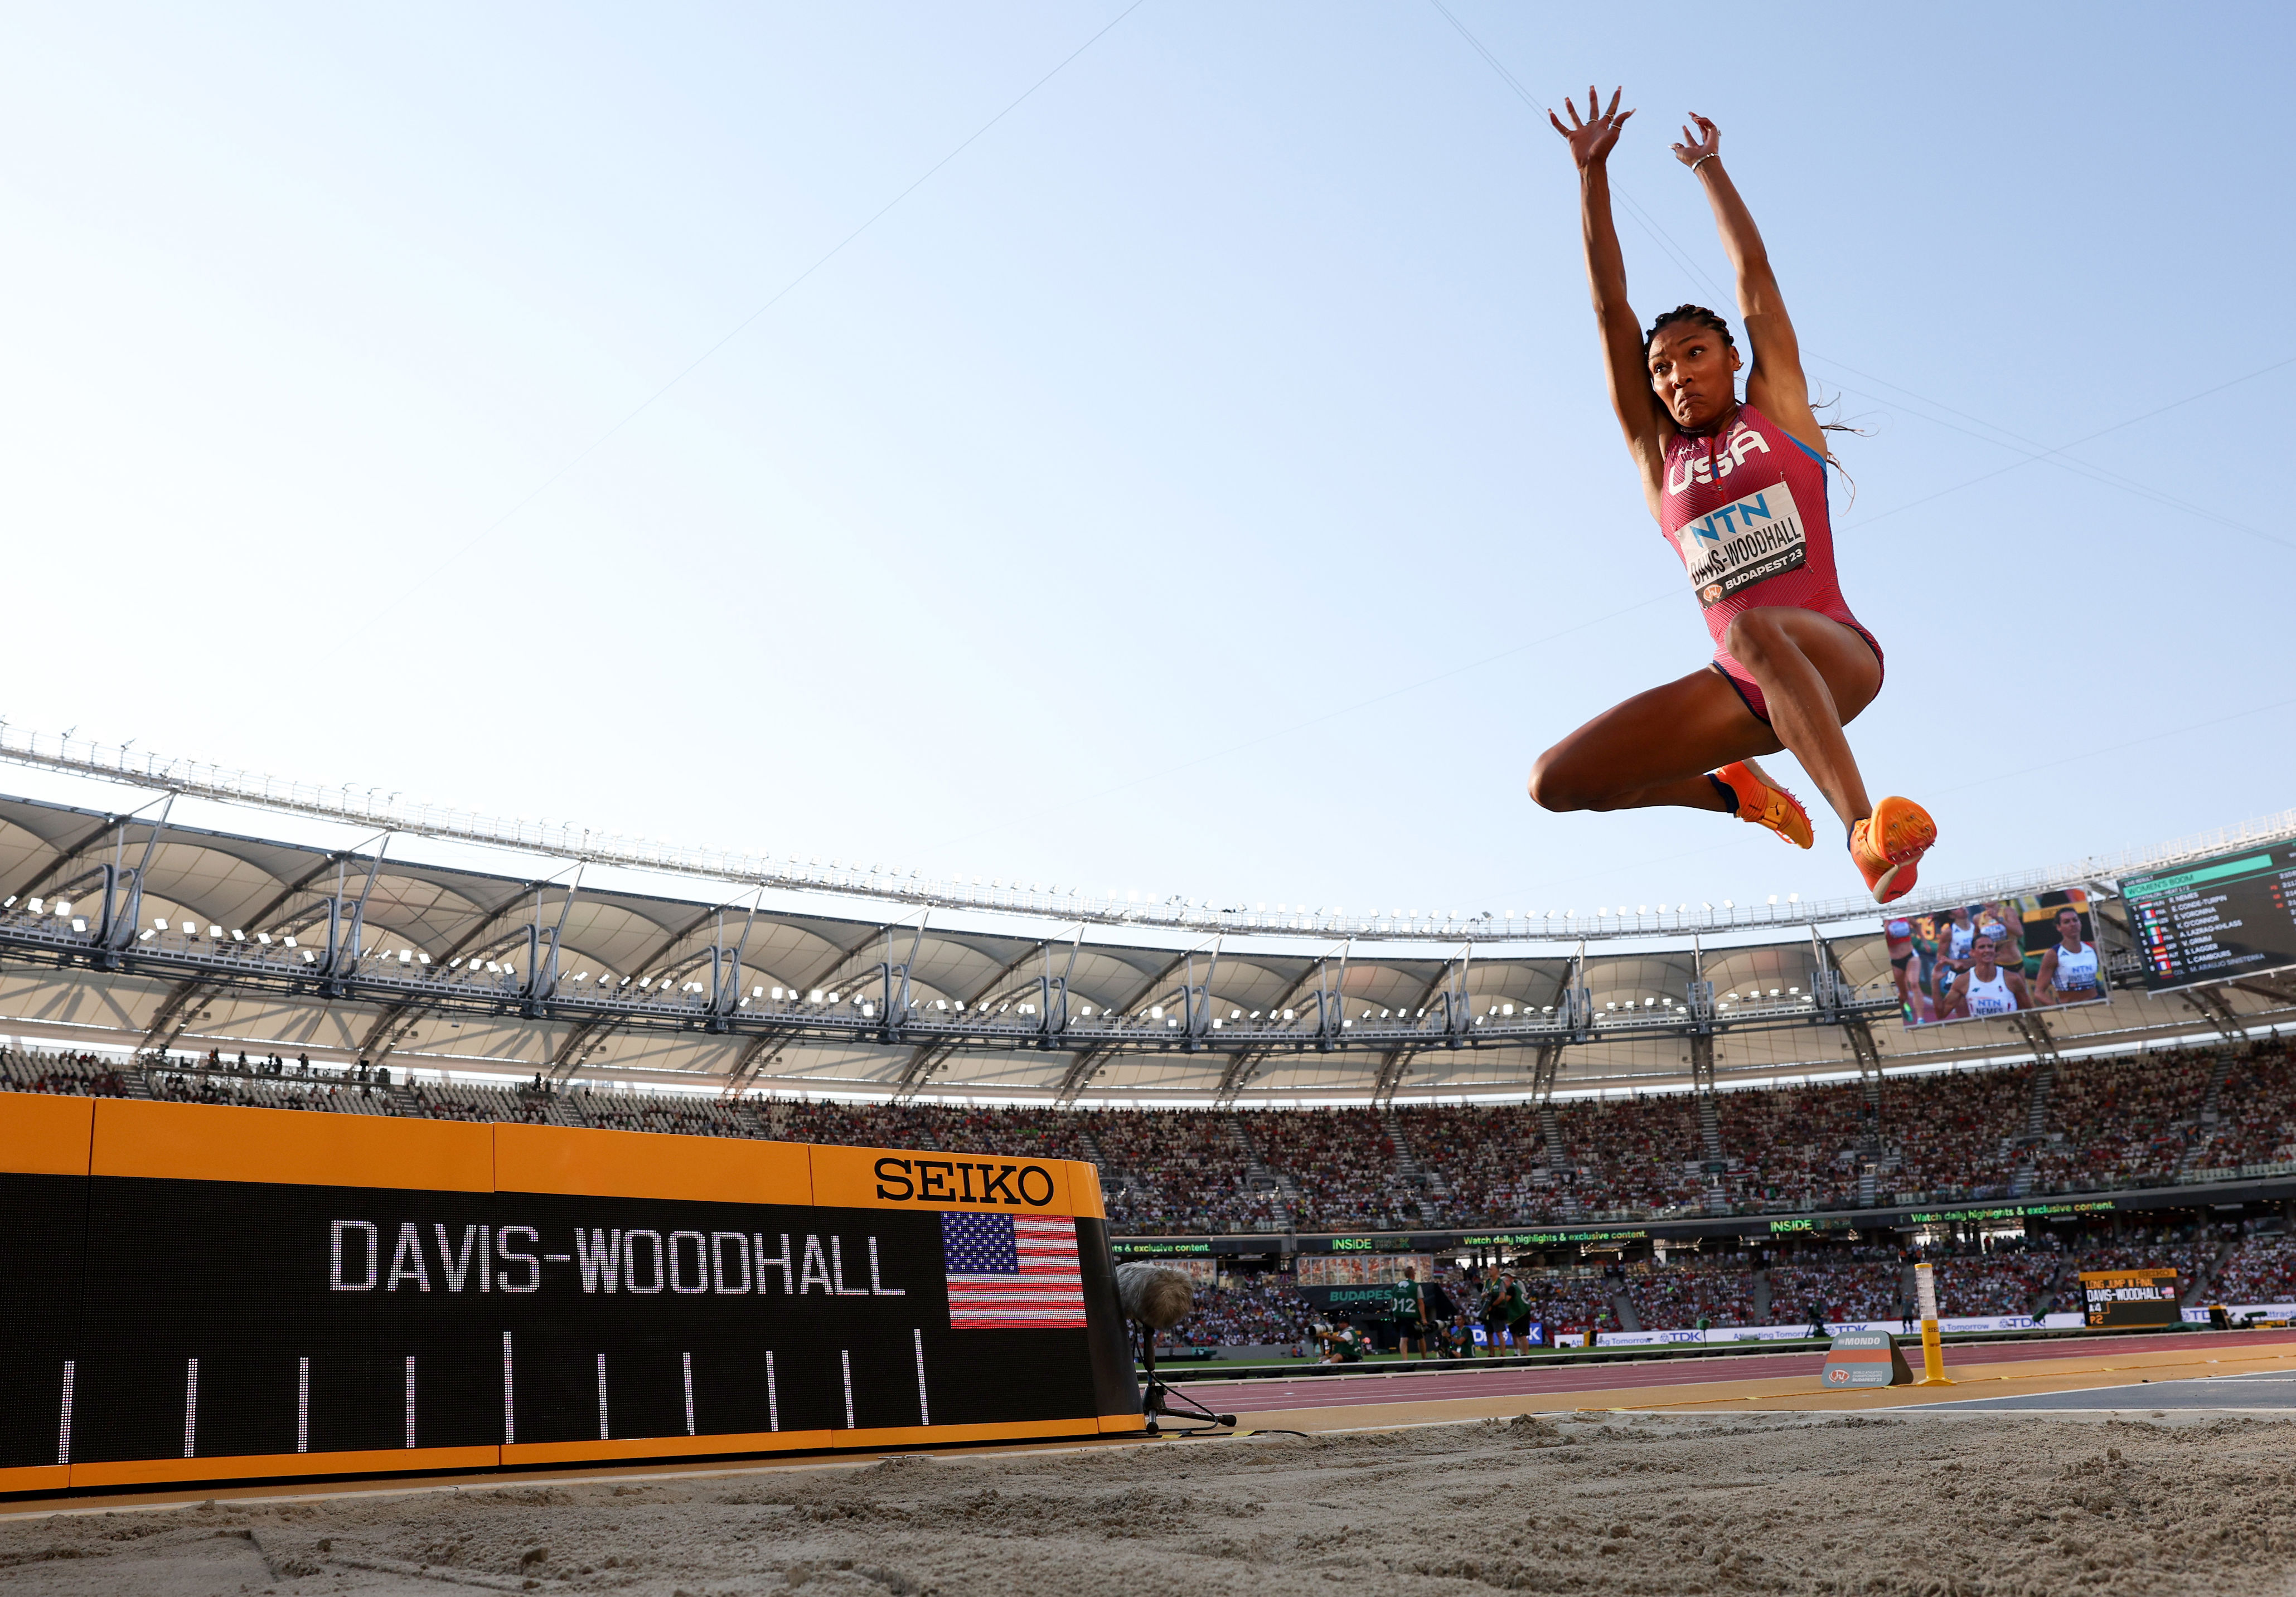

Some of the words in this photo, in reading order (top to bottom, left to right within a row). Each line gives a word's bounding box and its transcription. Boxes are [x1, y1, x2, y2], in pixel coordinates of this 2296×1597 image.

[1669, 430, 1771, 496] USA
[1690, 493, 1771, 548] NTN
[1690, 517, 1801, 586] DAVIS-WOODHALL
[1725, 558, 1788, 590] BUDAPEST
[1789, 548, 1803, 564] 23
[2128, 880, 2168, 895] WOMEN'S
[2175, 891, 2199, 902] NEMES
[2178, 894, 2227, 911] CONDE-TURPIN
[2180, 906, 2217, 920] VORONINA
[2183, 915, 2220, 928] O'CONNOR
[2072, 965, 2092, 973] NTN
[874, 1157, 1054, 1207] SEIKO
[1911, 1212, 1943, 1222] Watch
[1944, 1210, 1966, 1222] daily
[1968, 1208, 2014, 1220] highlights
[2017, 1206, 2024, 1216] &
[2027, 1204, 2072, 1215] exclusive
[2074, 1201, 2115, 1212] content.
[1770, 1219, 1813, 1232] INSIDE
[1333, 1238, 1372, 1250] INSIDE
[1464, 1236, 1491, 1245] Watch
[1494, 1235, 1514, 1245] daily
[1515, 1233, 1557, 1245] highlights
[1559, 1232, 1567, 1241] &
[1568, 1231, 1609, 1241] exclusive
[1611, 1230, 1648, 1239] content.
[1125, 1244, 1132, 1252] &
[1134, 1243, 1173, 1252] exclusive
[1175, 1243, 1210, 1252] content.
[330, 1220, 905, 1295] DAVIS-WOODHALL
[2086, 1279, 2105, 1289] LONG
[2106, 1279, 2126, 1289] JUMP
[2127, 1279, 2134, 1287] W
[2136, 1278, 2157, 1287] FINAL
[1330, 1290, 1392, 1302] BUDAPES
[2086, 1287, 2163, 1302] DAVIS-WOODHALL
[2090, 1315, 2104, 1324] P2
[2190, 1310, 2211, 1320] TD
[1669, 1332, 1701, 1342] TDK
[1844, 1337, 1881, 1346] MONDO
